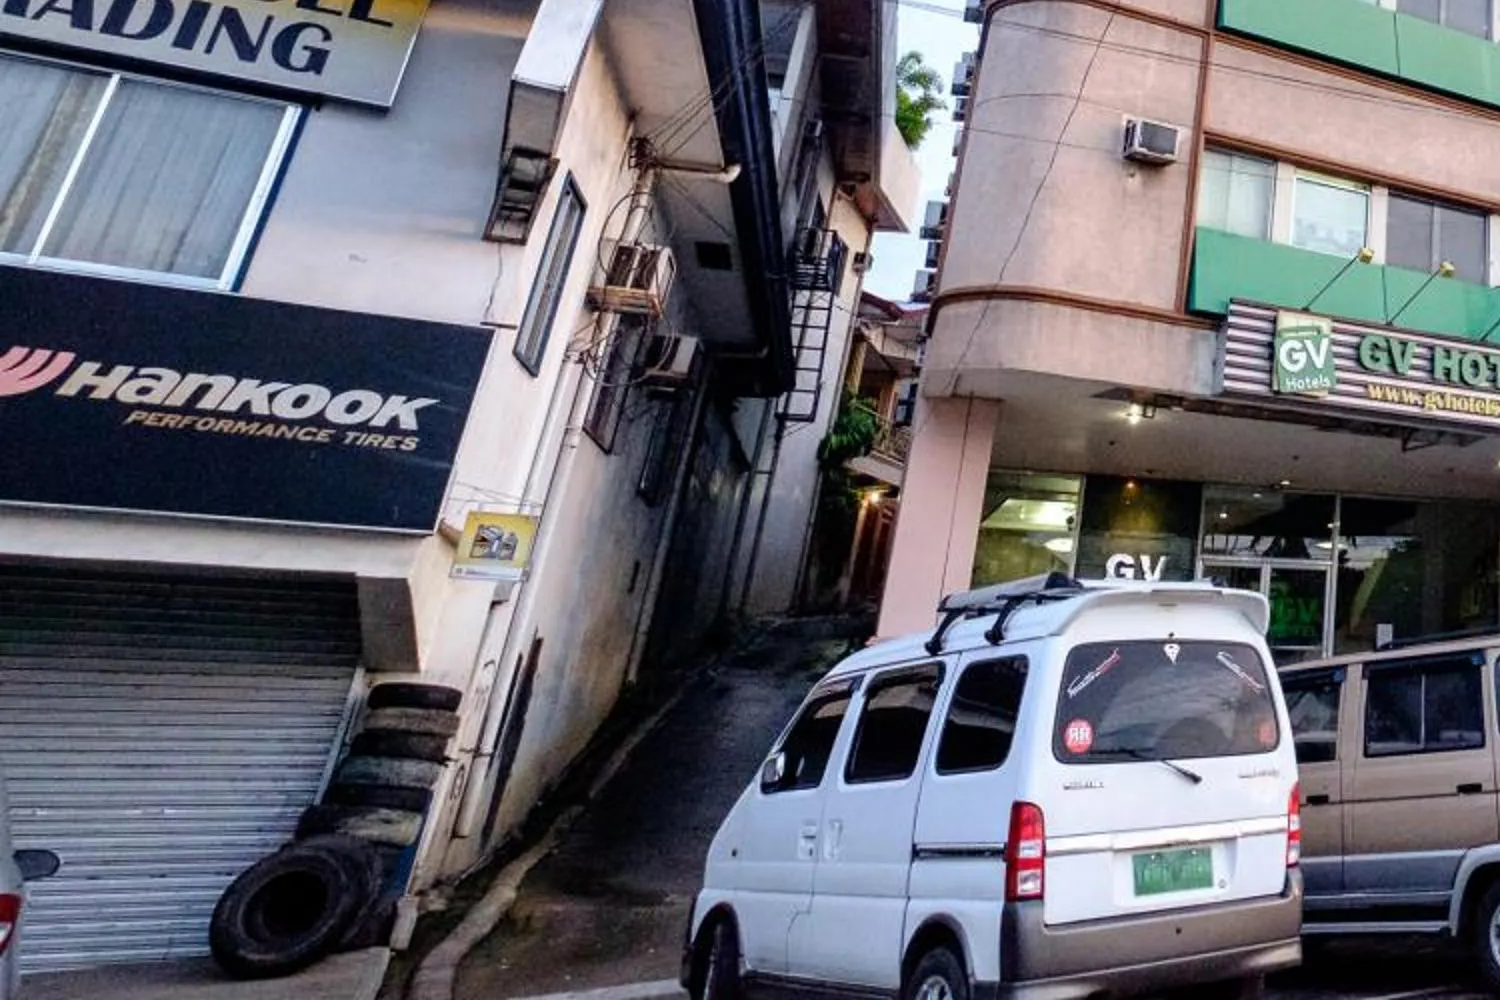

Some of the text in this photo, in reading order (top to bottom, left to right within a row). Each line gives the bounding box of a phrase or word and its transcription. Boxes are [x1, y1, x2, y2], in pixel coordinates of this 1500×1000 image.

[1279, 337, 1329, 373] GV
[1359, 335, 1418, 376] GV
[1285, 375, 1331, 390] Hotels
[123, 410, 420, 451] PERFORMANCE TIRES
[1105, 552, 1168, 581] GV
